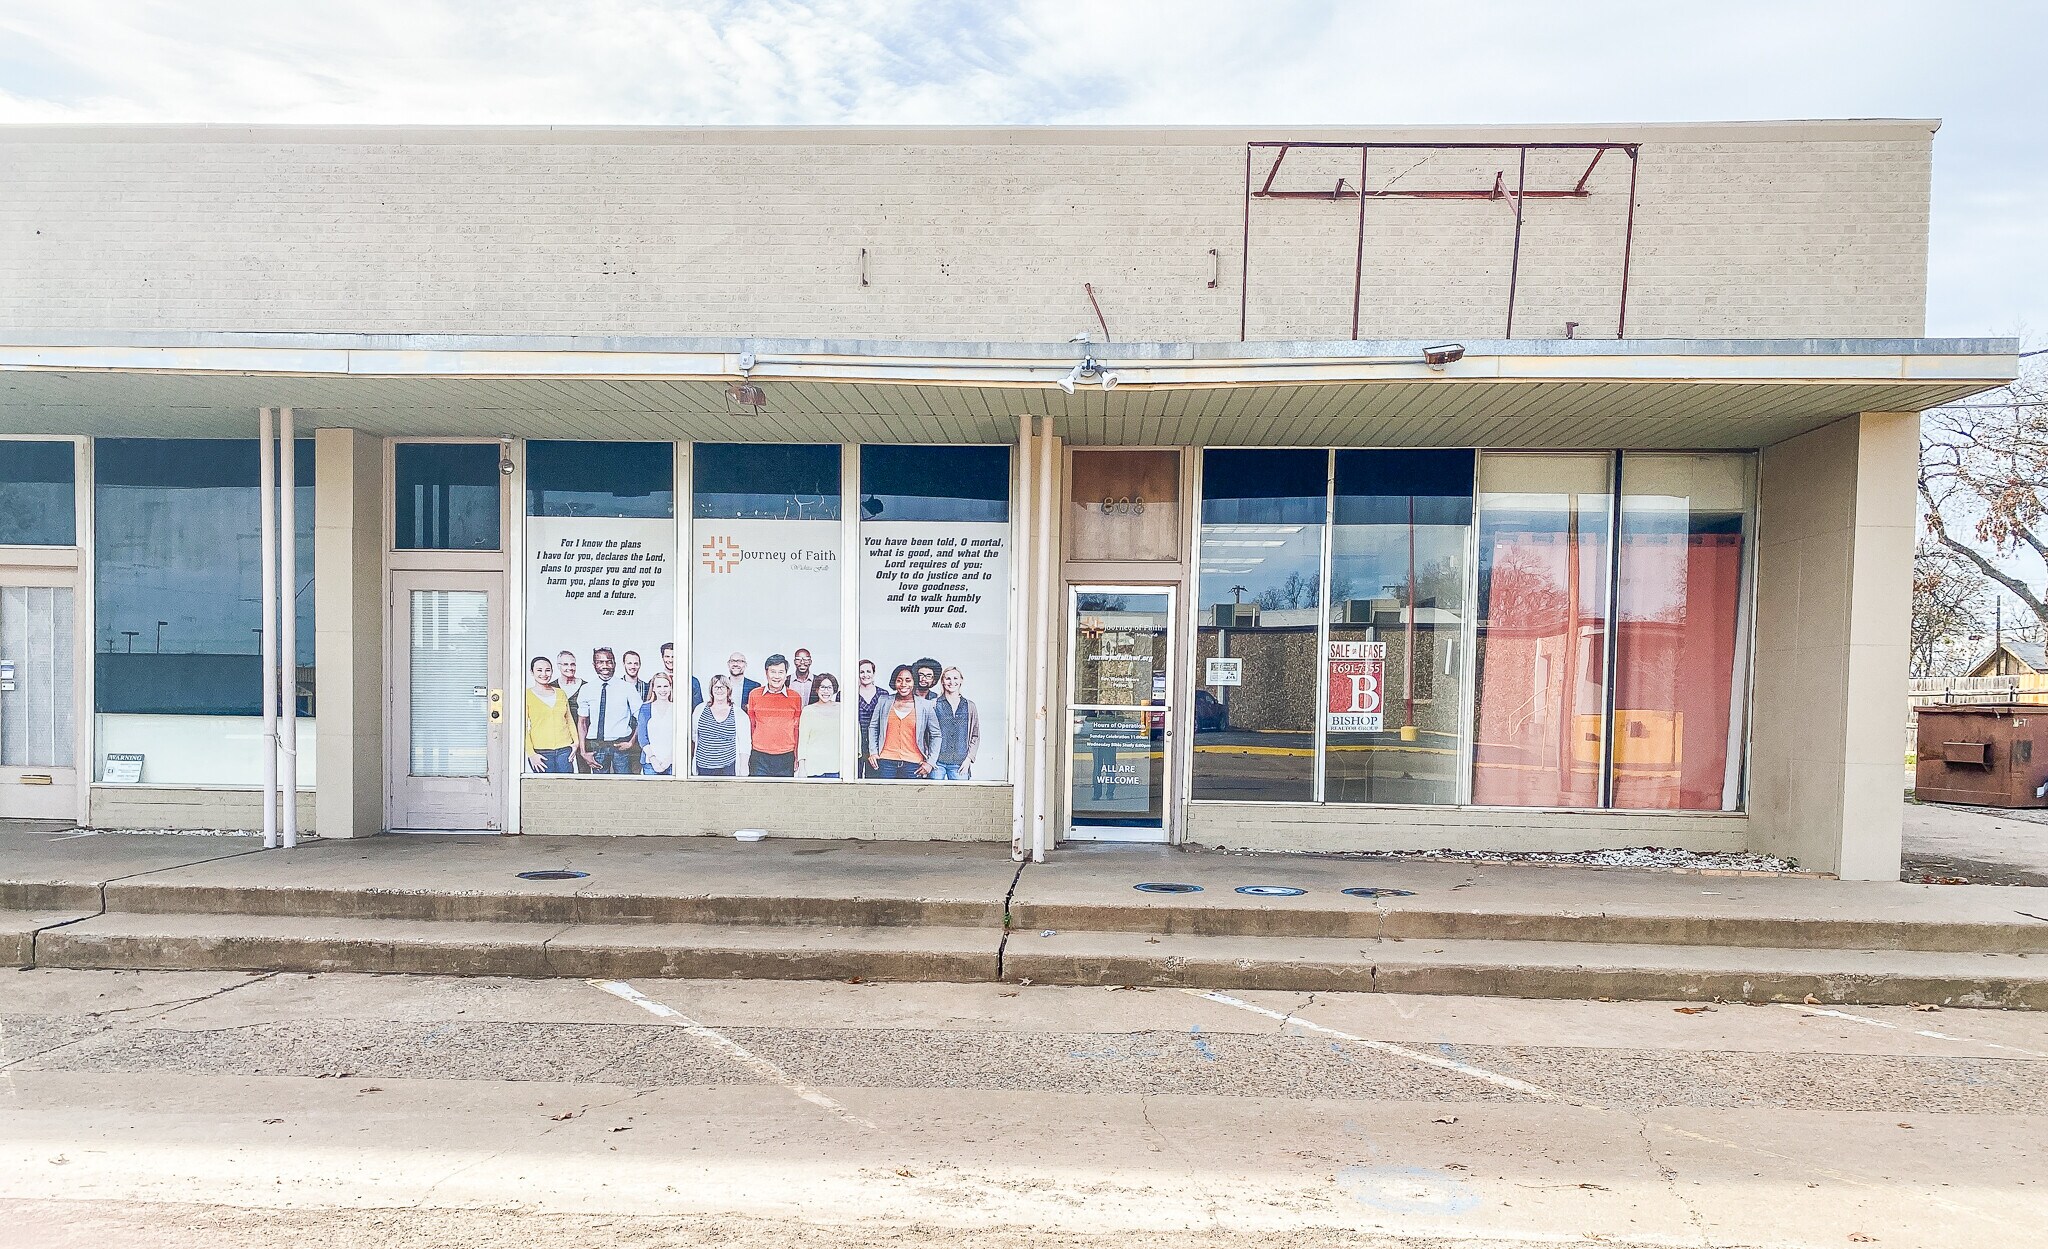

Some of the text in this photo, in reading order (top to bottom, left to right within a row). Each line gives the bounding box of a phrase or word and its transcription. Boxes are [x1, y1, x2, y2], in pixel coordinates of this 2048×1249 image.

[1101, 497, 1144, 515] 808
[561, 539, 573, 547] For
[576, 539, 579, 547] I
[582, 539, 602, 547] know
[620, 540, 641, 549] plans
[864, 537, 1004, 547] You have been told, O mortal,
[537, 551, 540, 559] I
[543, 551, 561, 559] have
[577, 553, 593, 561] you,
[596, 552, 628, 560] declares
[631, 553, 643, 561] the
[646, 553, 665, 562] Lord,
[740, 550, 836, 562] Journey of Faith
[908, 549, 932, 558] good,
[936, 549, 953, 557] and
[957, 550, 980, 558] what
[984, 550, 998, 558] the
[541, 565, 561, 573] plans
[574, 566, 603, 574] prosper
[885, 560, 905, 568] Lord
[909, 560, 947, 569] requires
[964, 562, 983, 570] you:
[876, 571, 897, 581] Only
[913, 571, 924, 579] do
[927, 571, 958, 581] justice
[983, 572, 991, 580] to
[547, 577, 566, 585] harm
[588, 578, 609, 587] plans
[622, 579, 638, 588] give
[642, 580, 655, 588] you
[899, 582, 968, 592] love goodness,
[565, 590, 584, 599] hope
[587, 590, 600, 598] and
[887, 593, 904, 601] and
[921, 594, 942, 602] walk
[946, 594, 981, 603] humbly
[900, 605, 919, 613] with
[924, 606, 944, 614] your
[1331, 644, 1350, 657] SALE
[1359, 644, 1383, 658] LEASE
[1347, 675, 1379, 711] B
[1332, 717, 1377, 725] BISHOP
